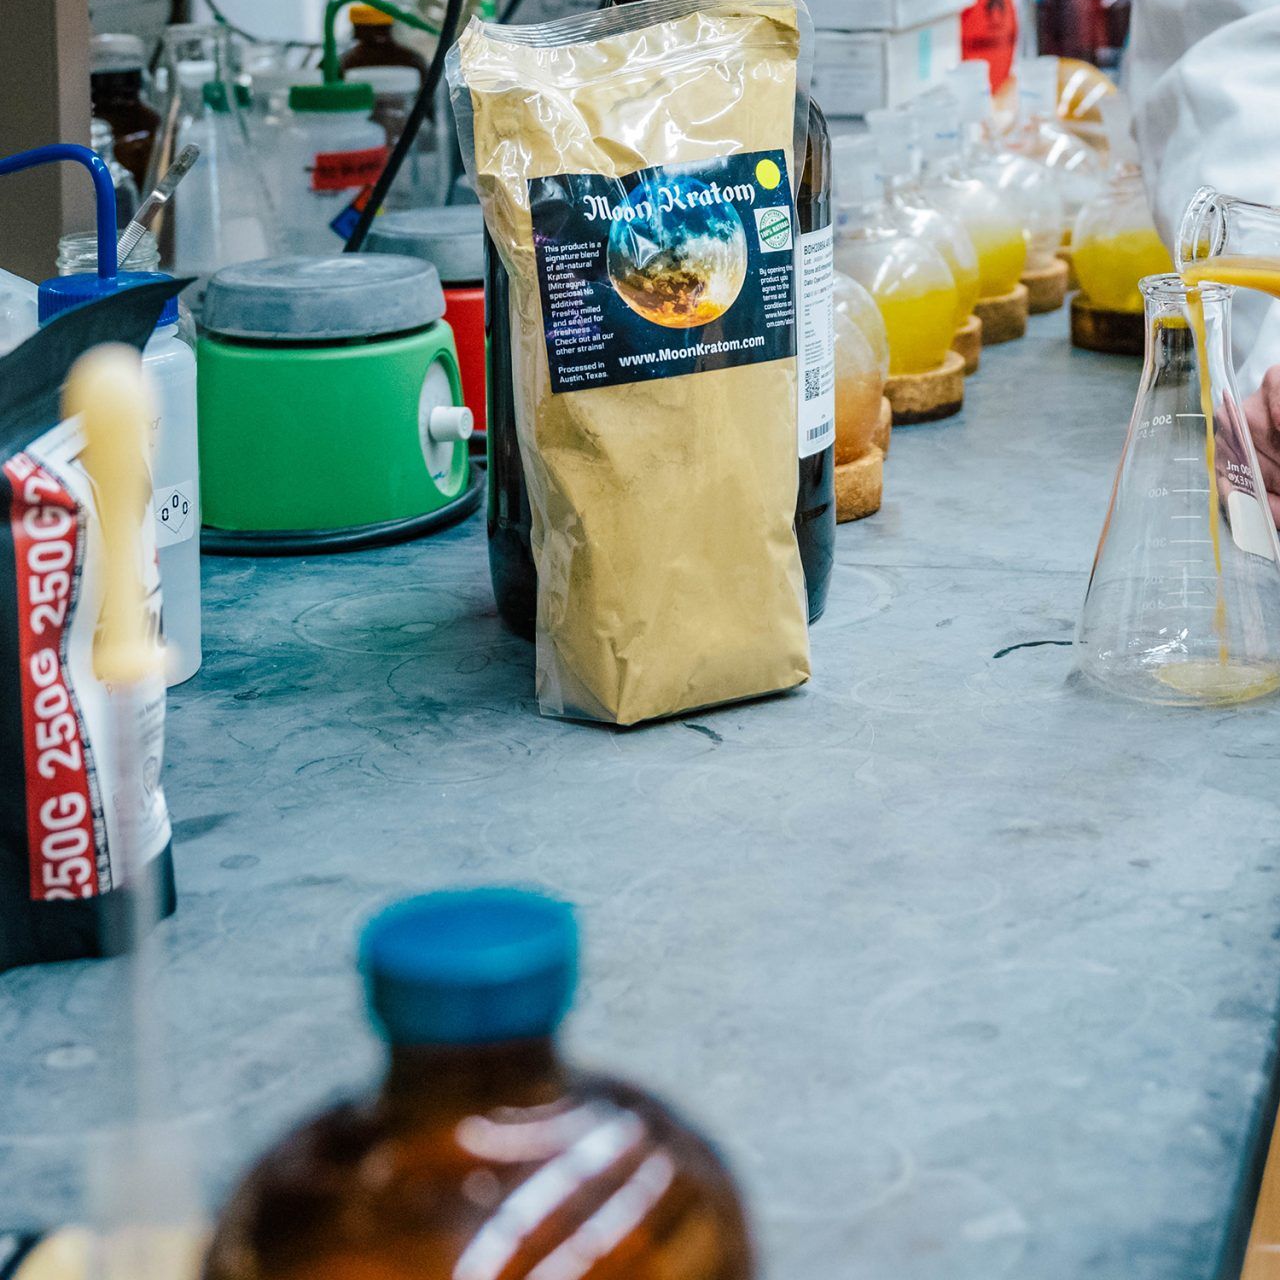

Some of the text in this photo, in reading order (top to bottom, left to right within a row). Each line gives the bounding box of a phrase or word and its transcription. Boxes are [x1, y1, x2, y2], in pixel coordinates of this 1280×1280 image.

[583, 181, 756, 222] Moon Kratom
[560, 242, 588, 253] product
[545, 250, 600, 264] signature blend
[546, 261, 593, 272] of all-natural
[760, 267, 767, 277] By
[767, 265, 786, 275] opening
[760, 275, 788, 286] product you
[583, 288, 594, 296] No
[762, 285, 776, 294] agree
[550, 299, 584, 309] additives.
[764, 301, 787, 310] conditions
[552, 305, 601, 318] Freshly milled
[553, 320, 567, 328] and
[568, 316, 592, 325] sealed
[553, 326, 591, 336] freshness.
[555, 337, 577, 347] Check
[556, 342, 605, 356] other strains!
[619, 334, 765, 368] www.MoonKratom.com
[558, 362, 597, 374] Processed
[559, 372, 609, 383] Austin, Texas.
[23, 506, 73, 635] 250G
[30, 647, 82, 779] 250G
